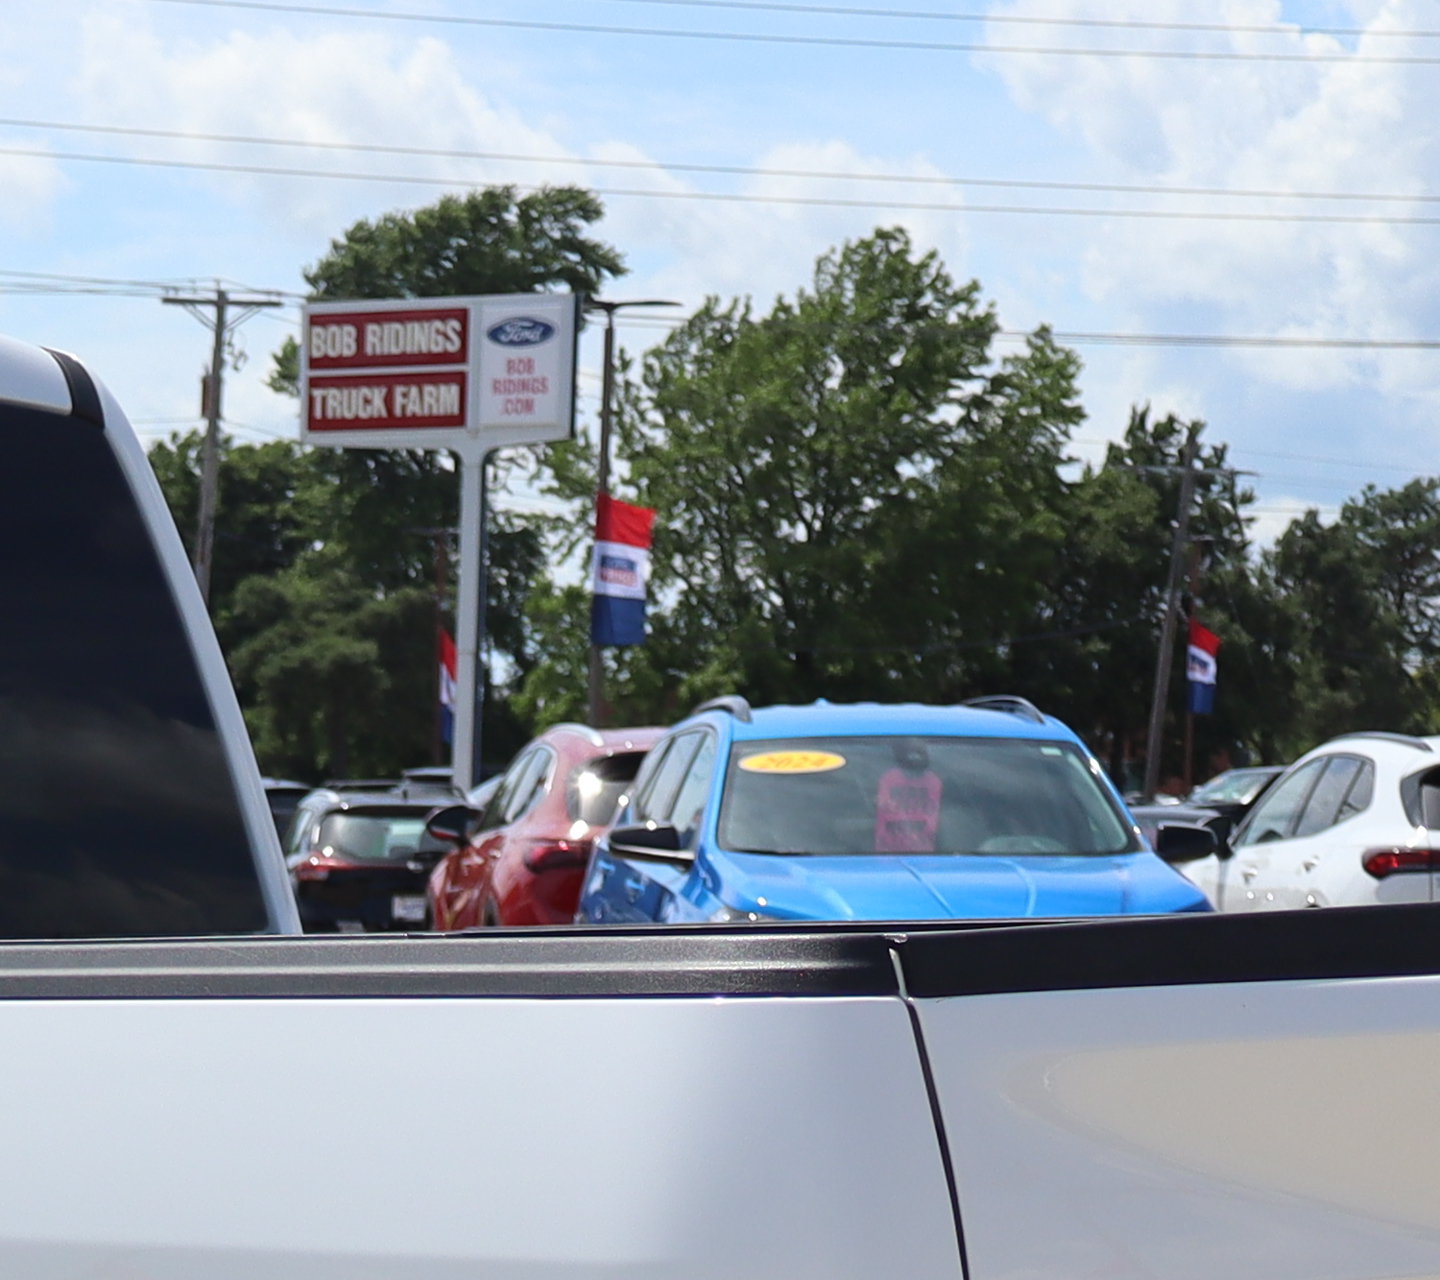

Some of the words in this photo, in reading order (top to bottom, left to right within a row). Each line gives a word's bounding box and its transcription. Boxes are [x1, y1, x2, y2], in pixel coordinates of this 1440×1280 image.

[310, 324, 358, 358] BOB
[366, 318, 462, 356] RIDINGS
[498, 319, 545, 342] Ford
[506, 357, 535, 375] BOB
[492, 376, 549, 395] RIDINGS
[311, 386, 388, 420] TRUCK
[393, 382, 461, 418] FARM
